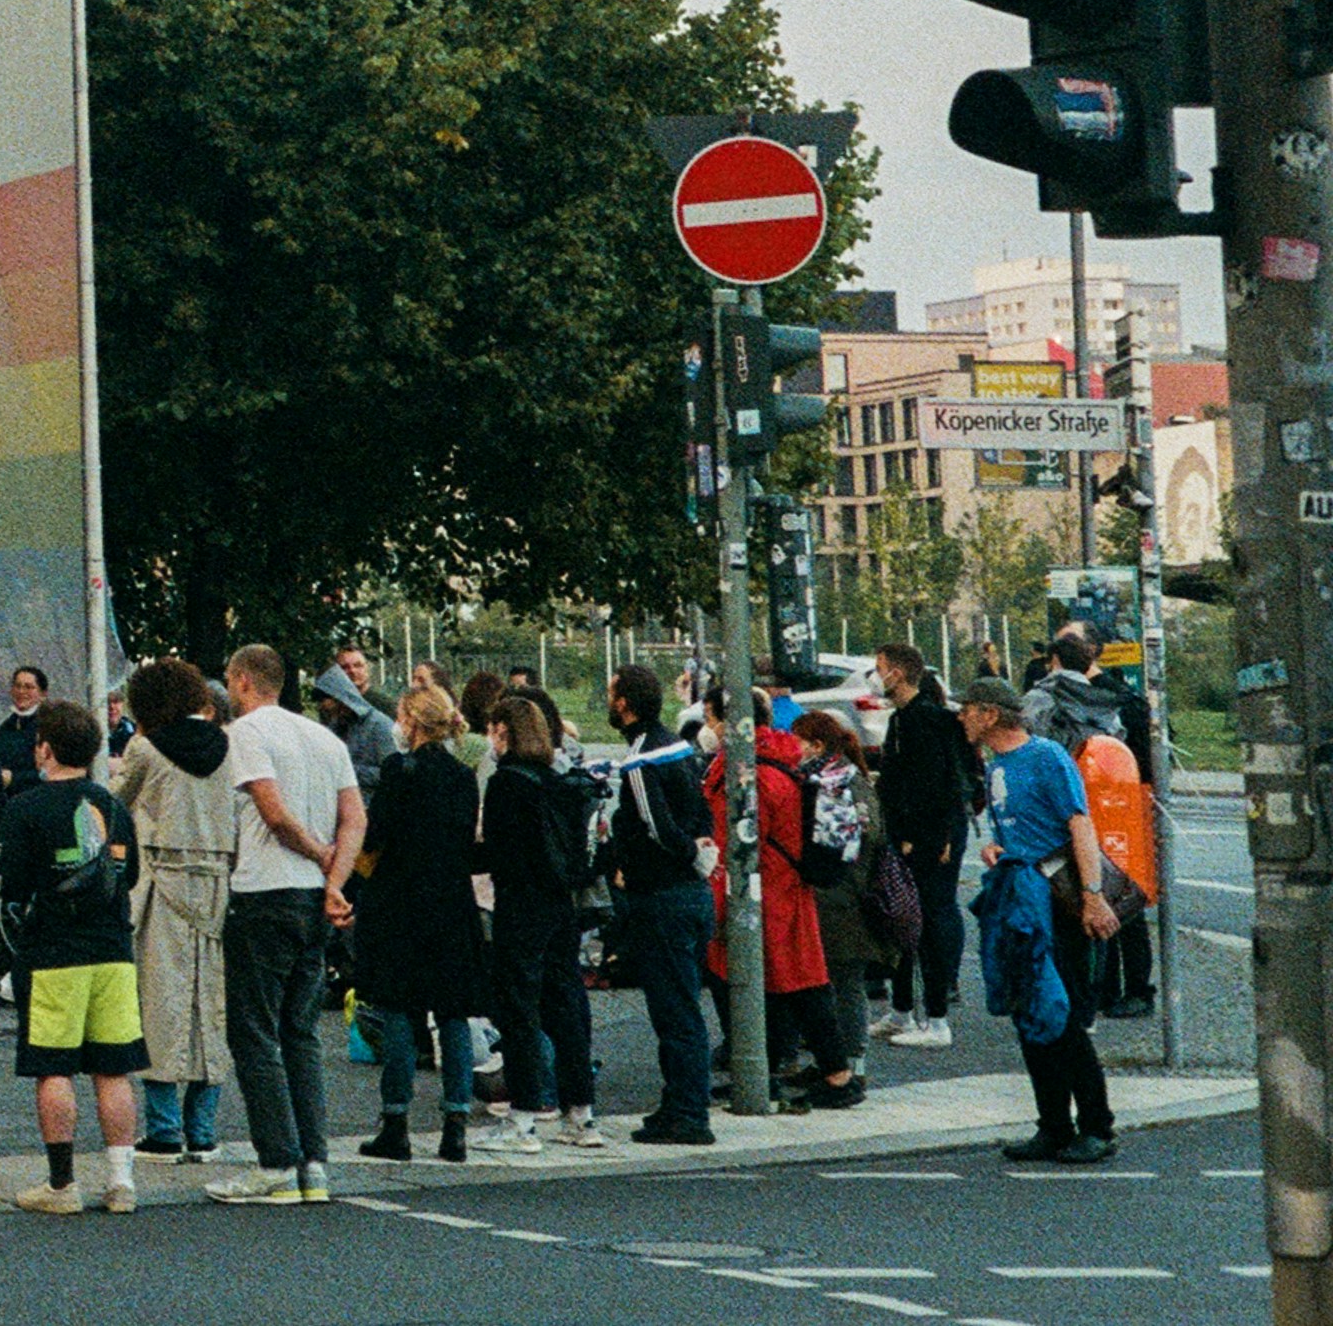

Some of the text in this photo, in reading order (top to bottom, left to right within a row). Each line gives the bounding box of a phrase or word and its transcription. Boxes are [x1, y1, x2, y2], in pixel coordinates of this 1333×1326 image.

[979, 370, 1060, 388] best way
[935, 407, 1109, 438] Köpenicker Straße
